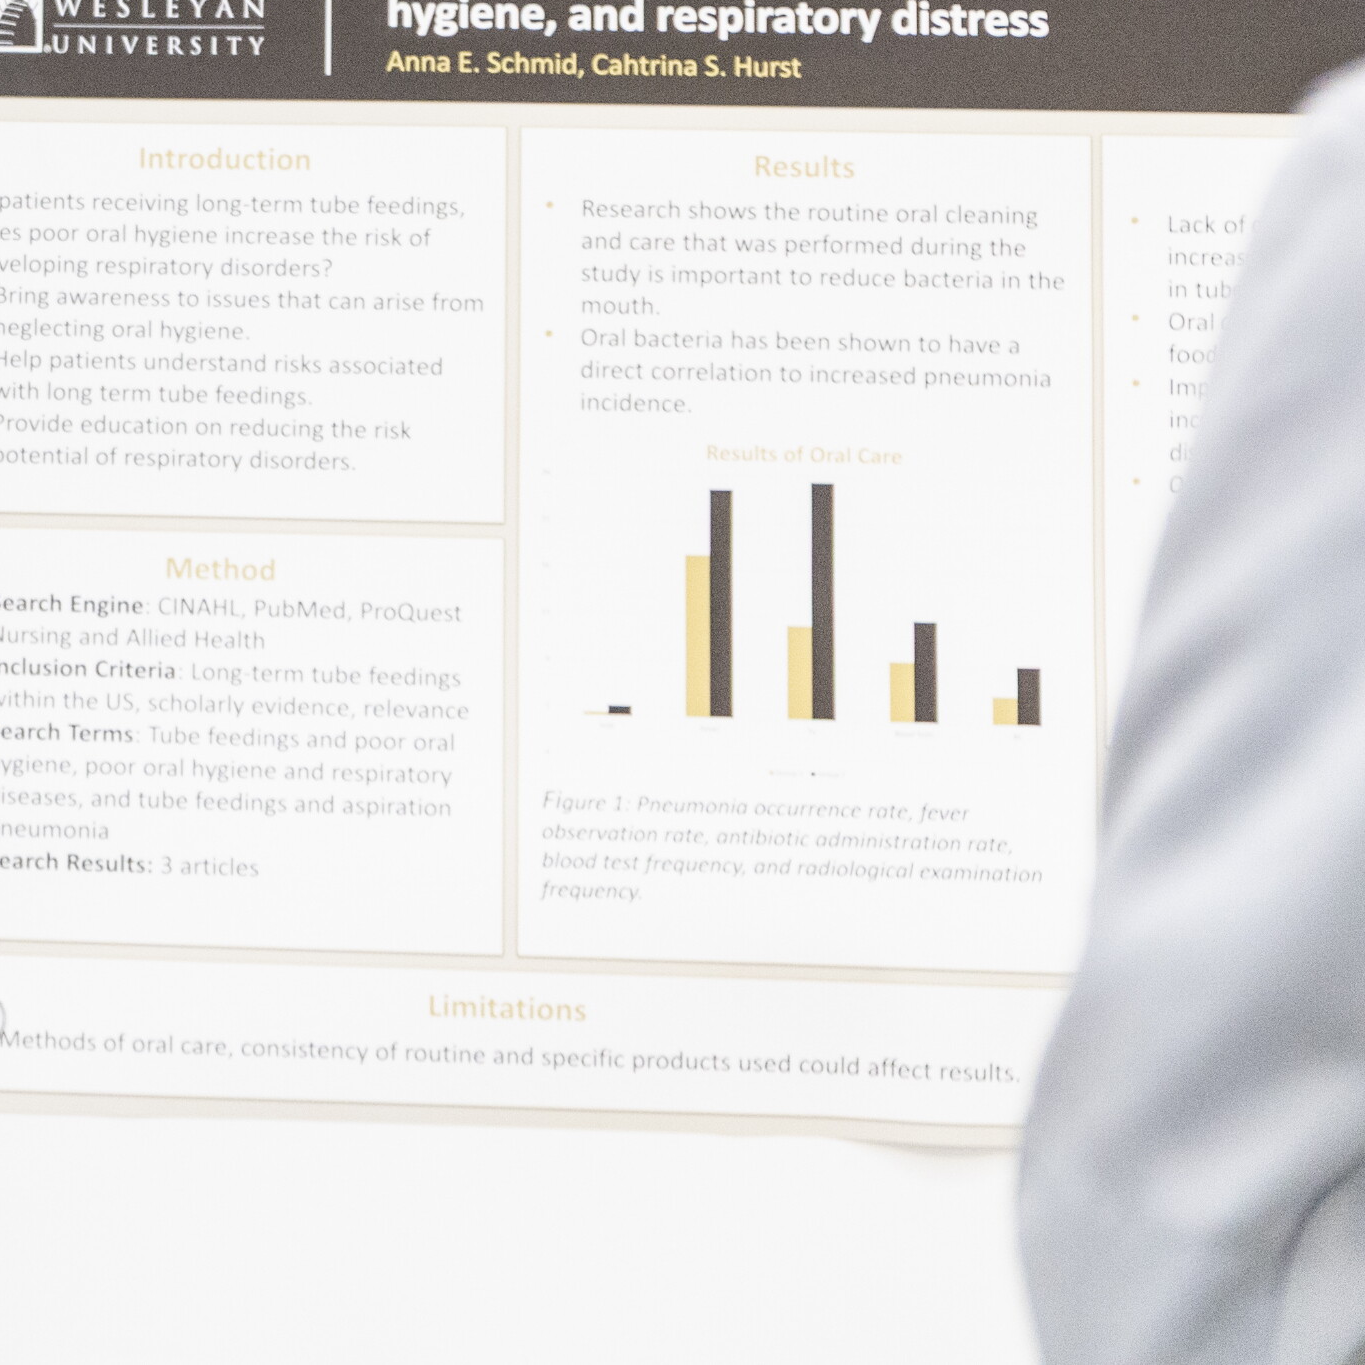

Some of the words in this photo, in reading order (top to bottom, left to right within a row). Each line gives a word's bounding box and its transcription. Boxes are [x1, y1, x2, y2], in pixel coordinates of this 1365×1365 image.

[892, 0, 1048, 37] distress
[51, 35, 264, 55] UNIVERSITY
[387, 51, 450, 71] Anna
[459, 51, 479, 73] E.
[488, 51, 583, 78] Schmid,
[592, 54, 697, 76] Cahtrina
[705, 56, 725, 76] S.
[735, 57, 801, 78] Hurst
[140, 146, 311, 171] Introduction
[755, 155, 855, 178] Results
[92, 194, 189, 216] receiving
[196, 194, 302, 217] long-term
[310, 195, 360, 215] tube
[367, 195, 464, 221] feedings,
[582, 199, 681, 218] Research
[688, 201, 757, 221] shows
[764, 202, 800, 221] the
[808, 205, 888, 222] routine
[896, 204, 937, 223] oral
[945, 205, 1038, 230] cleaning
[29, 227, 79, 245] poor
[86, 224, 126, 242] oral
[134, 225, 217, 248] hygiene
[225, 226, 314, 245] increase
[322, 227, 357, 246] the
[365, 227, 401, 246] risk
[409, 228, 431, 247] of
[1168, 215, 1215, 234] Lack
[1224, 215, 1245, 234] of
[581, 231, 621, 250] and
[629, 237, 675, 251] care
[683, 233, 726, 252] that
[735, 238, 777, 253] was
[784, 235, 903, 257] performed
[910, 237, 982, 261] during
[989, 238, 1026, 257] the
[1168, 247, 1248, 267] increas
[96, 258, 213, 280] respiratory
[220, 258, 333, 278] disorders?
[581, 263, 641, 287] study
[648, 264, 664, 283] is
[672, 268, 781, 288] important
[790, 269, 812, 286] to
[820, 268, 896, 288] reduce
[904, 269, 993, 289] bacteria
[1001, 270, 1020, 289] in
[1028, 271, 1065, 290] the
[56, 291, 170, 307] awareness
[177, 291, 199, 308] to
[207, 289, 270, 309] issues
[277, 290, 321, 309] that
[328, 296, 365, 310] can
[373, 291, 425, 311] arise
[432, 292, 484, 312] from
[1168, 281, 1188, 298] in
[1195, 279, 1233, 299] tub
[581, 296, 659, 315] mouth.
[111, 320, 152, 338] oral
[160, 320, 249, 344] hygiene.
[1168, 313, 1215, 332] Oral
[580, 328, 626, 347] Oral
[634, 329, 723, 349] bacteria
[731, 330, 768, 350] has
[776, 331, 830, 351] been
[838, 332, 911, 352] shown
[918, 336, 941, 353] to
[949, 334, 1001, 354] have
[1008, 340, 1020, 354] a
[49, 352, 136, 373] patients
[144, 353, 266, 373] understand
[274, 355, 322, 374] risks
[329, 357, 443, 376] associated
[580, 359, 642, 380] direct
[651, 363, 772, 382] correlation
[779, 366, 802, 383] to
[810, 365, 916, 385] increased
[924, 371, 1051, 389] pneumonia
[581, 393, 691, 413] incidence.
[95, 446, 116, 466] of
[124, 451, 242, 472] respiratory
[249, 450, 355, 470] disorders.
[706, 444, 778, 462] Results
[783, 445, 804, 463] of
[809, 446, 851, 464] Oral
[857, 447, 903, 465] Care
[166, 557, 276, 581] Method
[69, 594, 149, 619] Engine:
[158, 596, 246, 620] CINAHL,
[254, 599, 352, 622] PubMed,
[361, 601, 461, 623] ProQuest
[94, 659, 182, 681] Criteria:
[191, 662, 304, 686] Long-term
[311, 665, 361, 685] tube
[368, 665, 461, 692] feedings
[68, 722, 139, 744] Terms:
[149, 725, 200, 745] Tube
[207, 726, 300, 752] feedings
[306, 730, 347, 749] and
[355, 734, 406, 753] poor
[413, 732, 455, 752] oral
[542, 789, 607, 815] Figure
[614, 795, 631, 812] 1:
[637, 795, 748, 815] Pneumonia
[753, 802, 862, 818] occurrence
[919, 802, 969, 824] fever
[66, 852, 152, 875] Results:
[162, 855, 173, 874] 3
[180, 858, 259, 877] articles
[429, 994, 586, 1022] Limitations
[103, 1033, 124, 1051] of
[132, 1035, 173, 1053] oral
[181, 1040, 232, 1057] care,
[241, 1042, 368, 1064] consistency
[375, 1042, 397, 1060] of
[405, 1046, 485, 1064] routine
[493, 1046, 534, 1065] and
[542, 1048, 623, 1070] specific
[632, 1051, 731, 1073] products
[739, 1053, 791, 1073] used
[798, 1055, 860, 1076] could
[867, 1056, 930, 1080] affect
[940, 1063, 1019, 1082] results.
